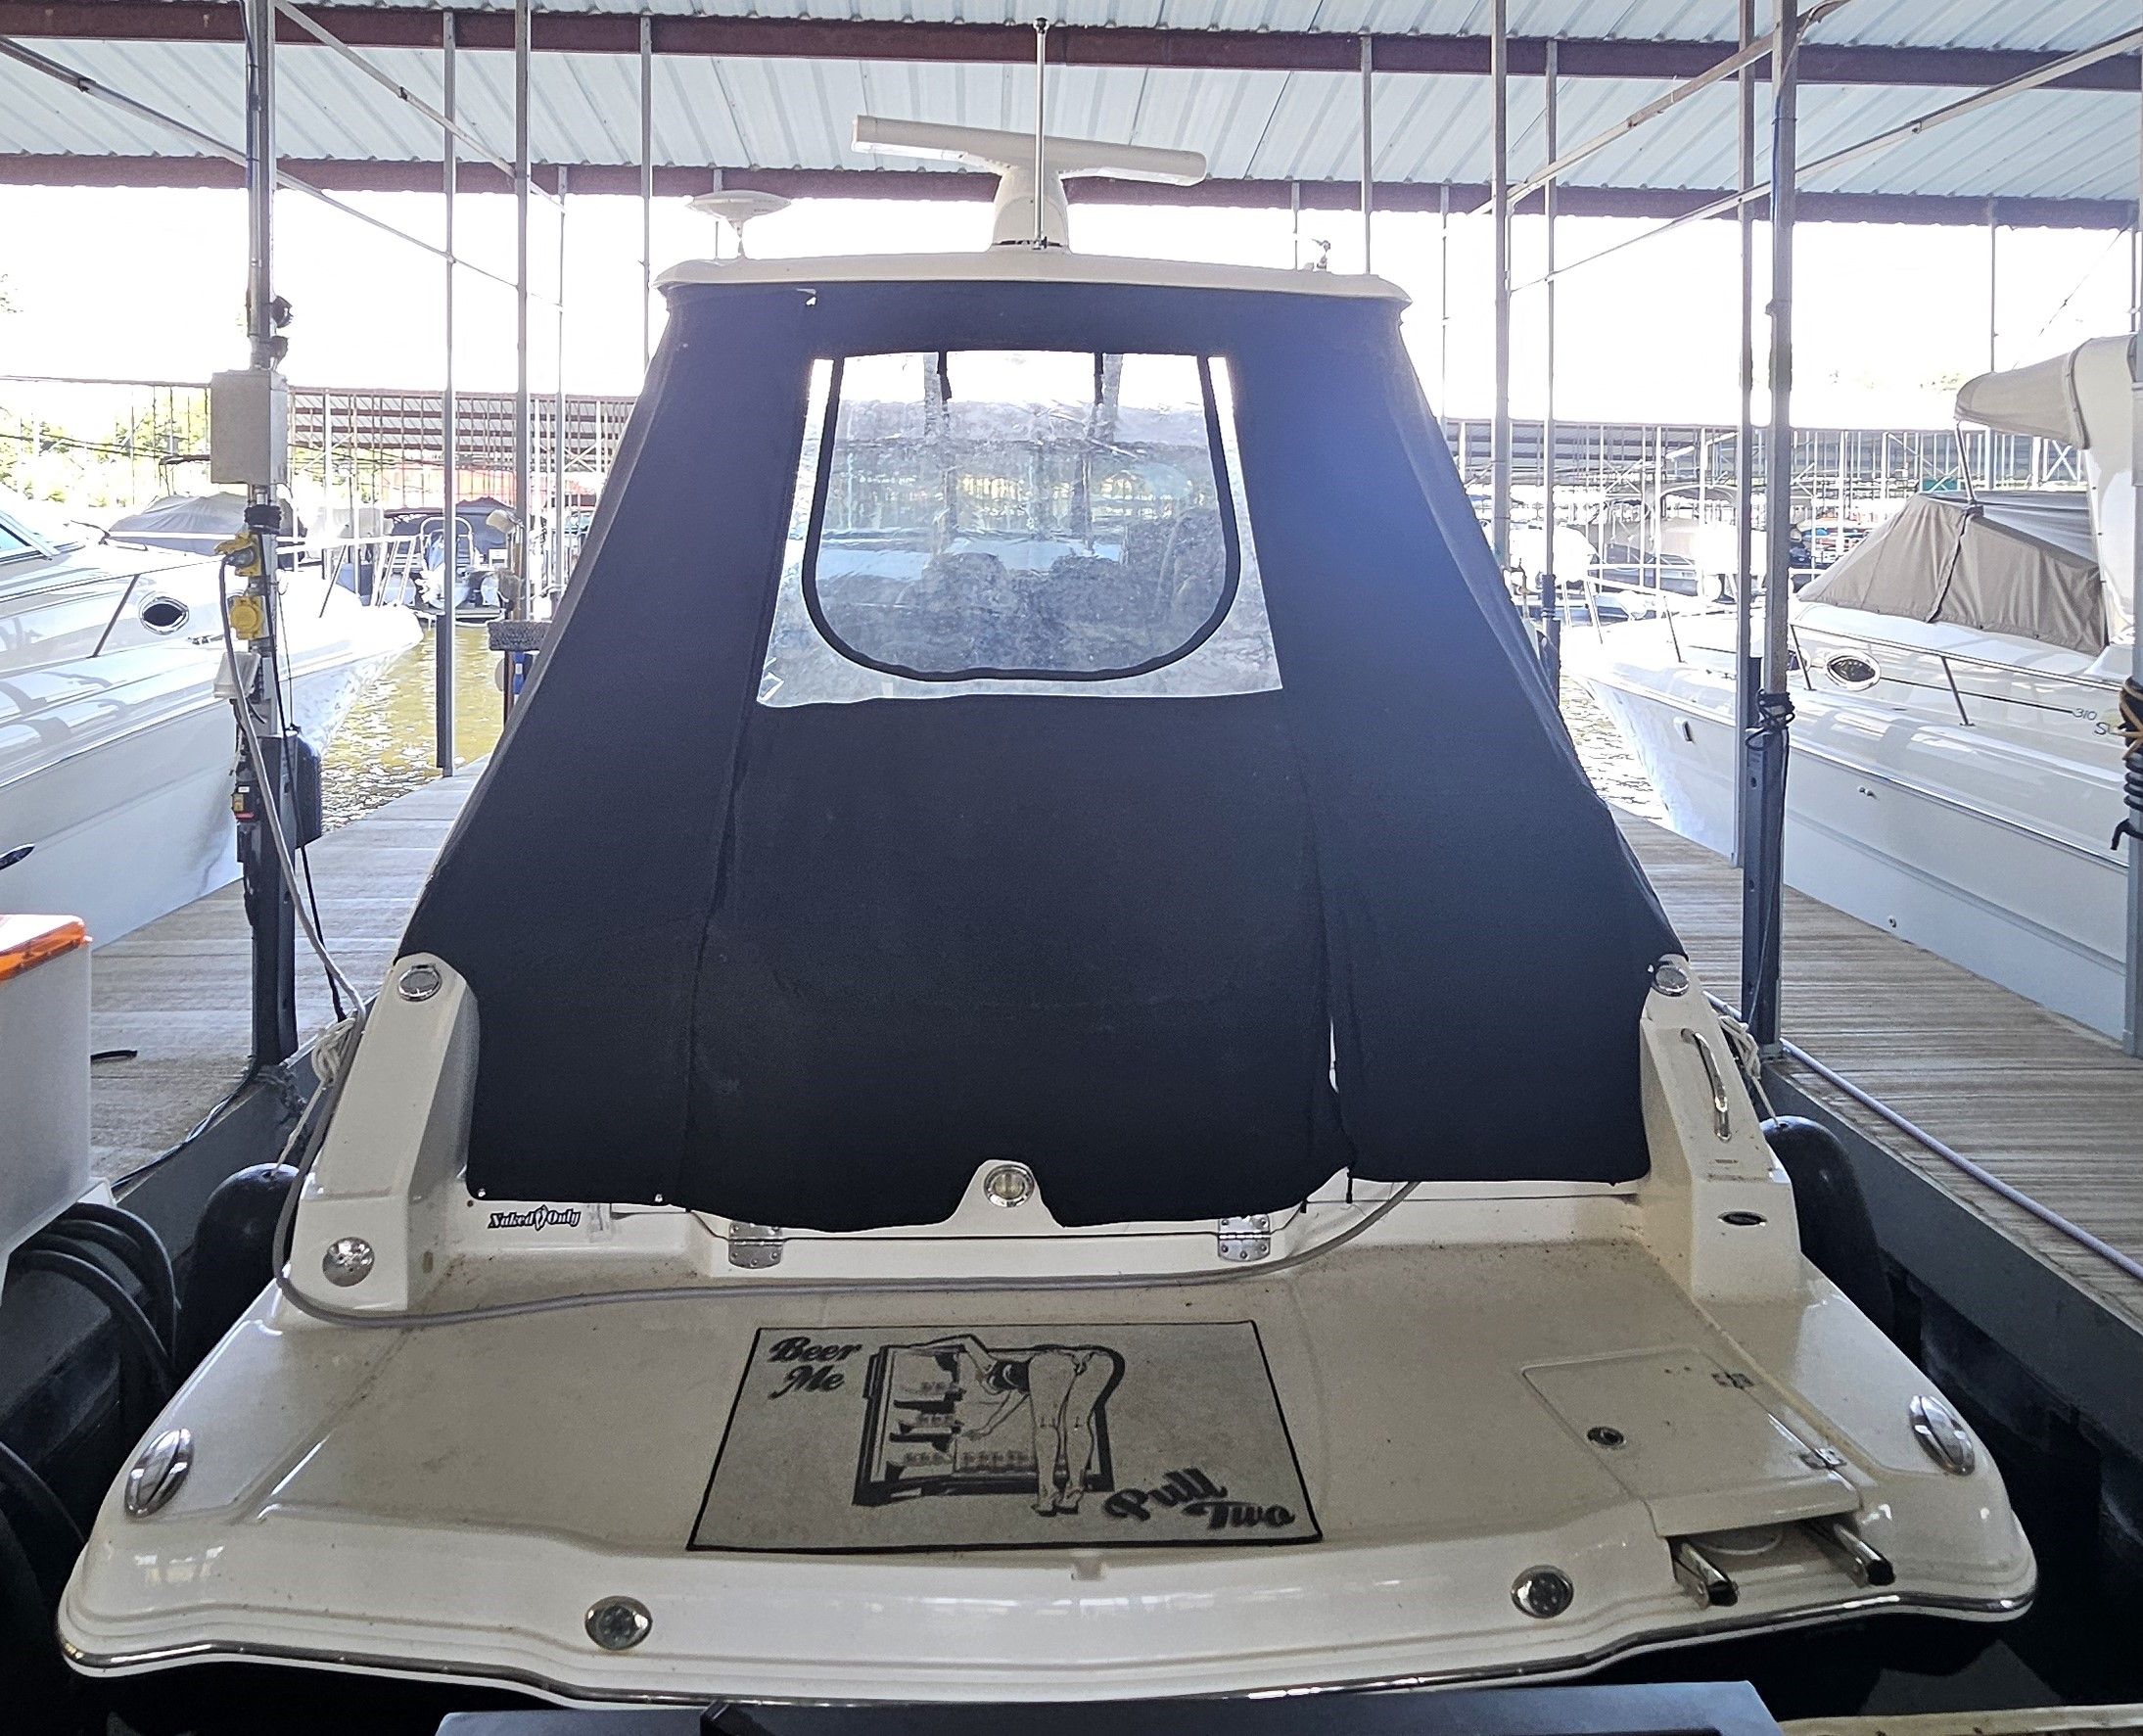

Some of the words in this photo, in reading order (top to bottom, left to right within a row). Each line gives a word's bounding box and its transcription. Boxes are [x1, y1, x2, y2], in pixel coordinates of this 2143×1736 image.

[2073, 708, 2097, 721] 310
[488, 1212, 535, 1228] Naked
[548, 1208, 581, 1227] Only
[768, 1337, 863, 1363] Beer
[767, 1365, 845, 1399] Me
[1103, 1467, 1228, 1522] Pull
[1180, 1501, 1296, 1529] Two
